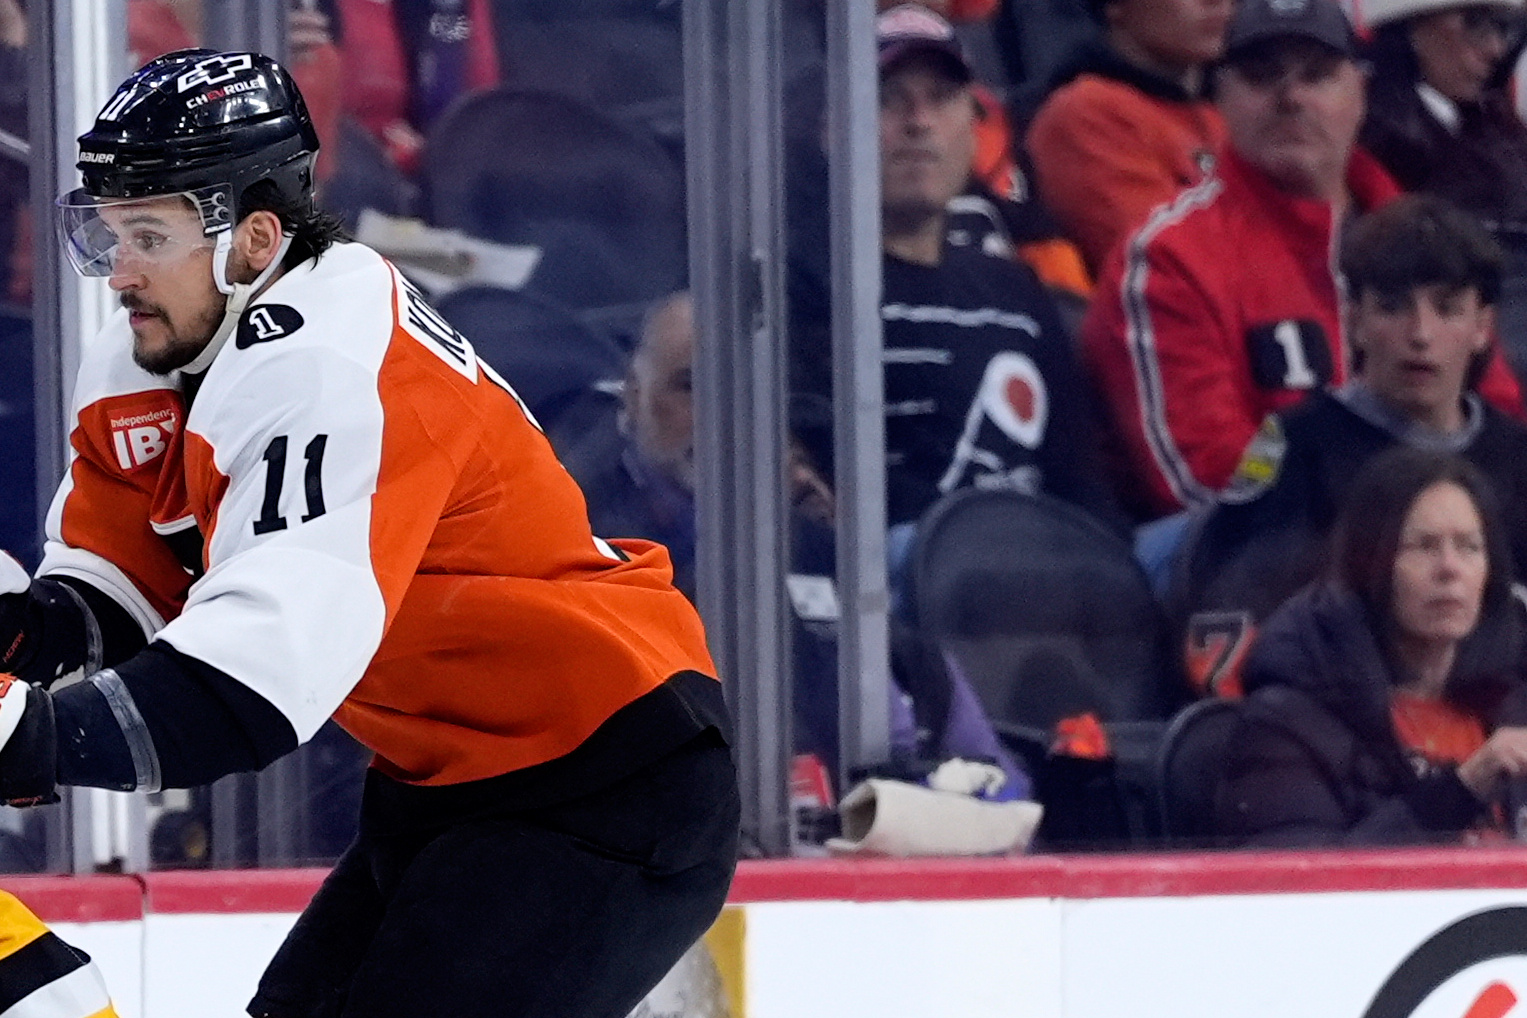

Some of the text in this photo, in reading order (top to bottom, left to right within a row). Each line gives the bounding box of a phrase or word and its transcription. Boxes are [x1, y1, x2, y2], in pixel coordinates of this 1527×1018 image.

[186, 74, 267, 110] CHEVROLE
[1275, 320, 1317, 390] 1
[253, 433, 328, 536] 11
